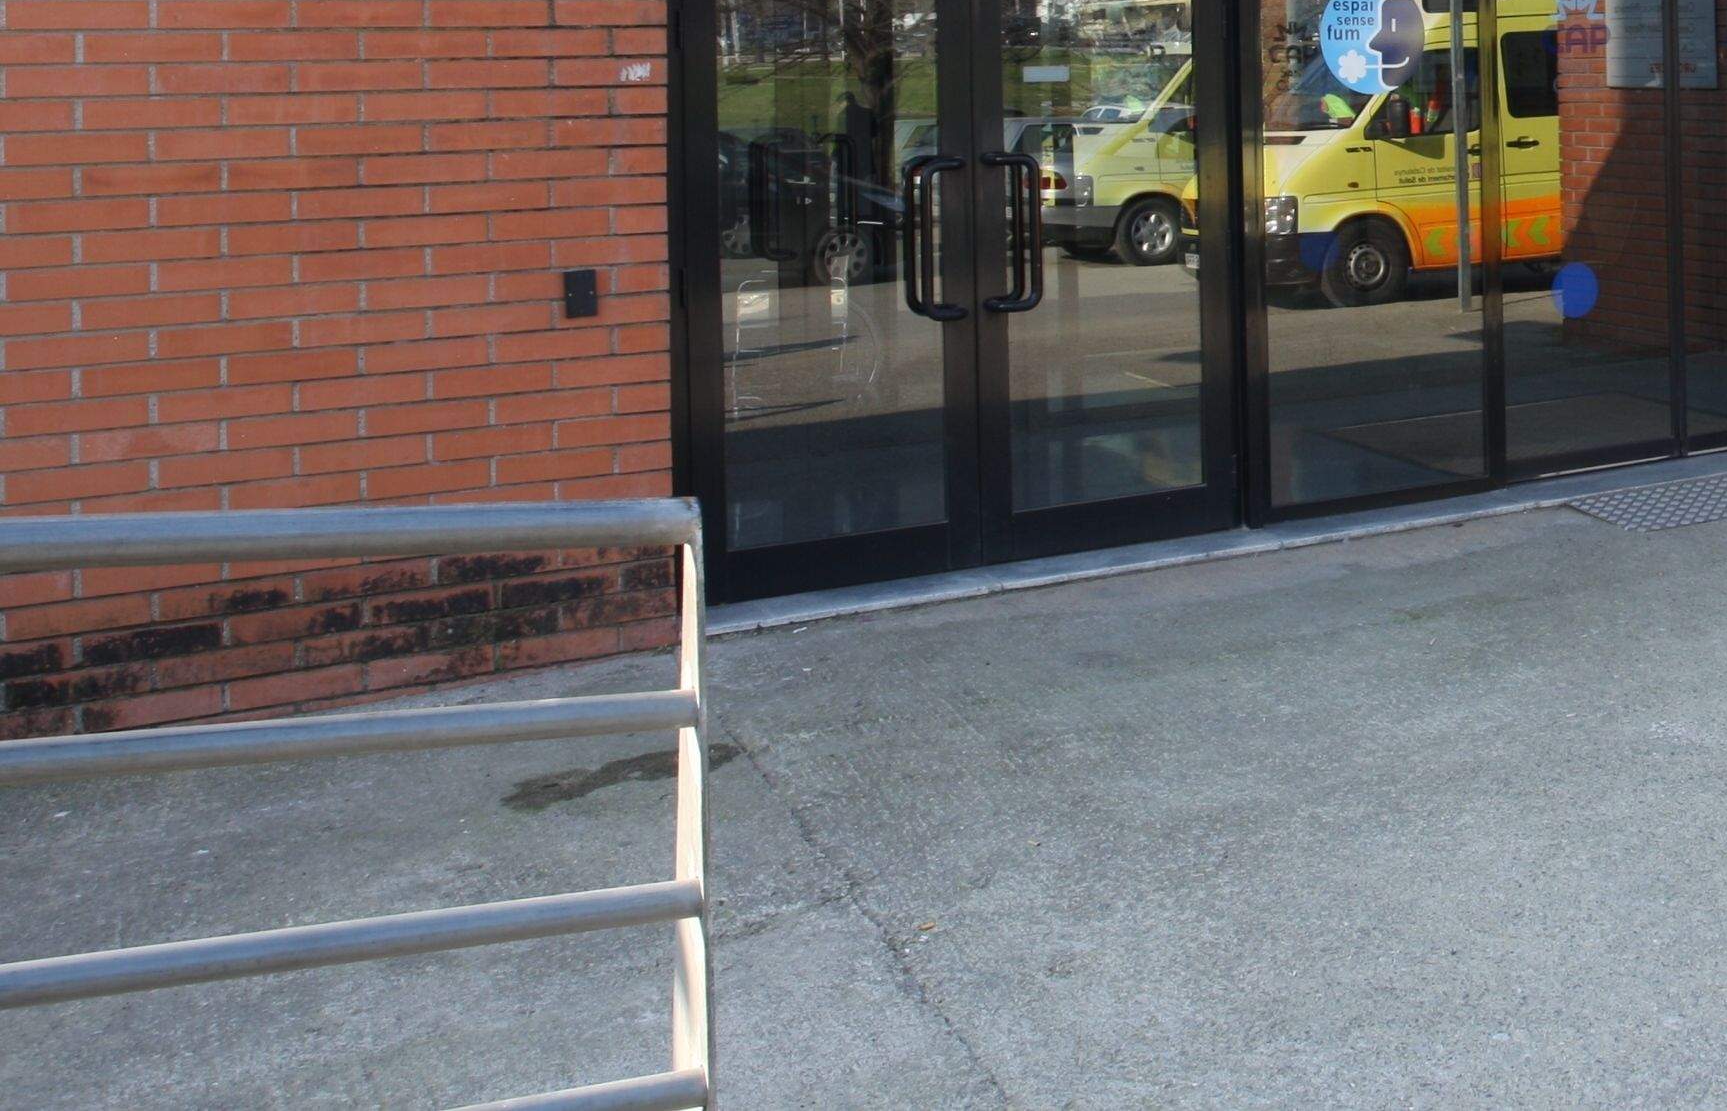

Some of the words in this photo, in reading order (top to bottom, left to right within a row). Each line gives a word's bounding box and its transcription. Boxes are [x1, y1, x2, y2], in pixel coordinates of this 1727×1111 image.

[1336, 16, 1375, 26] sense
[1327, 24, 1360, 41] fum
[1541, 24, 1611, 55] CAP
